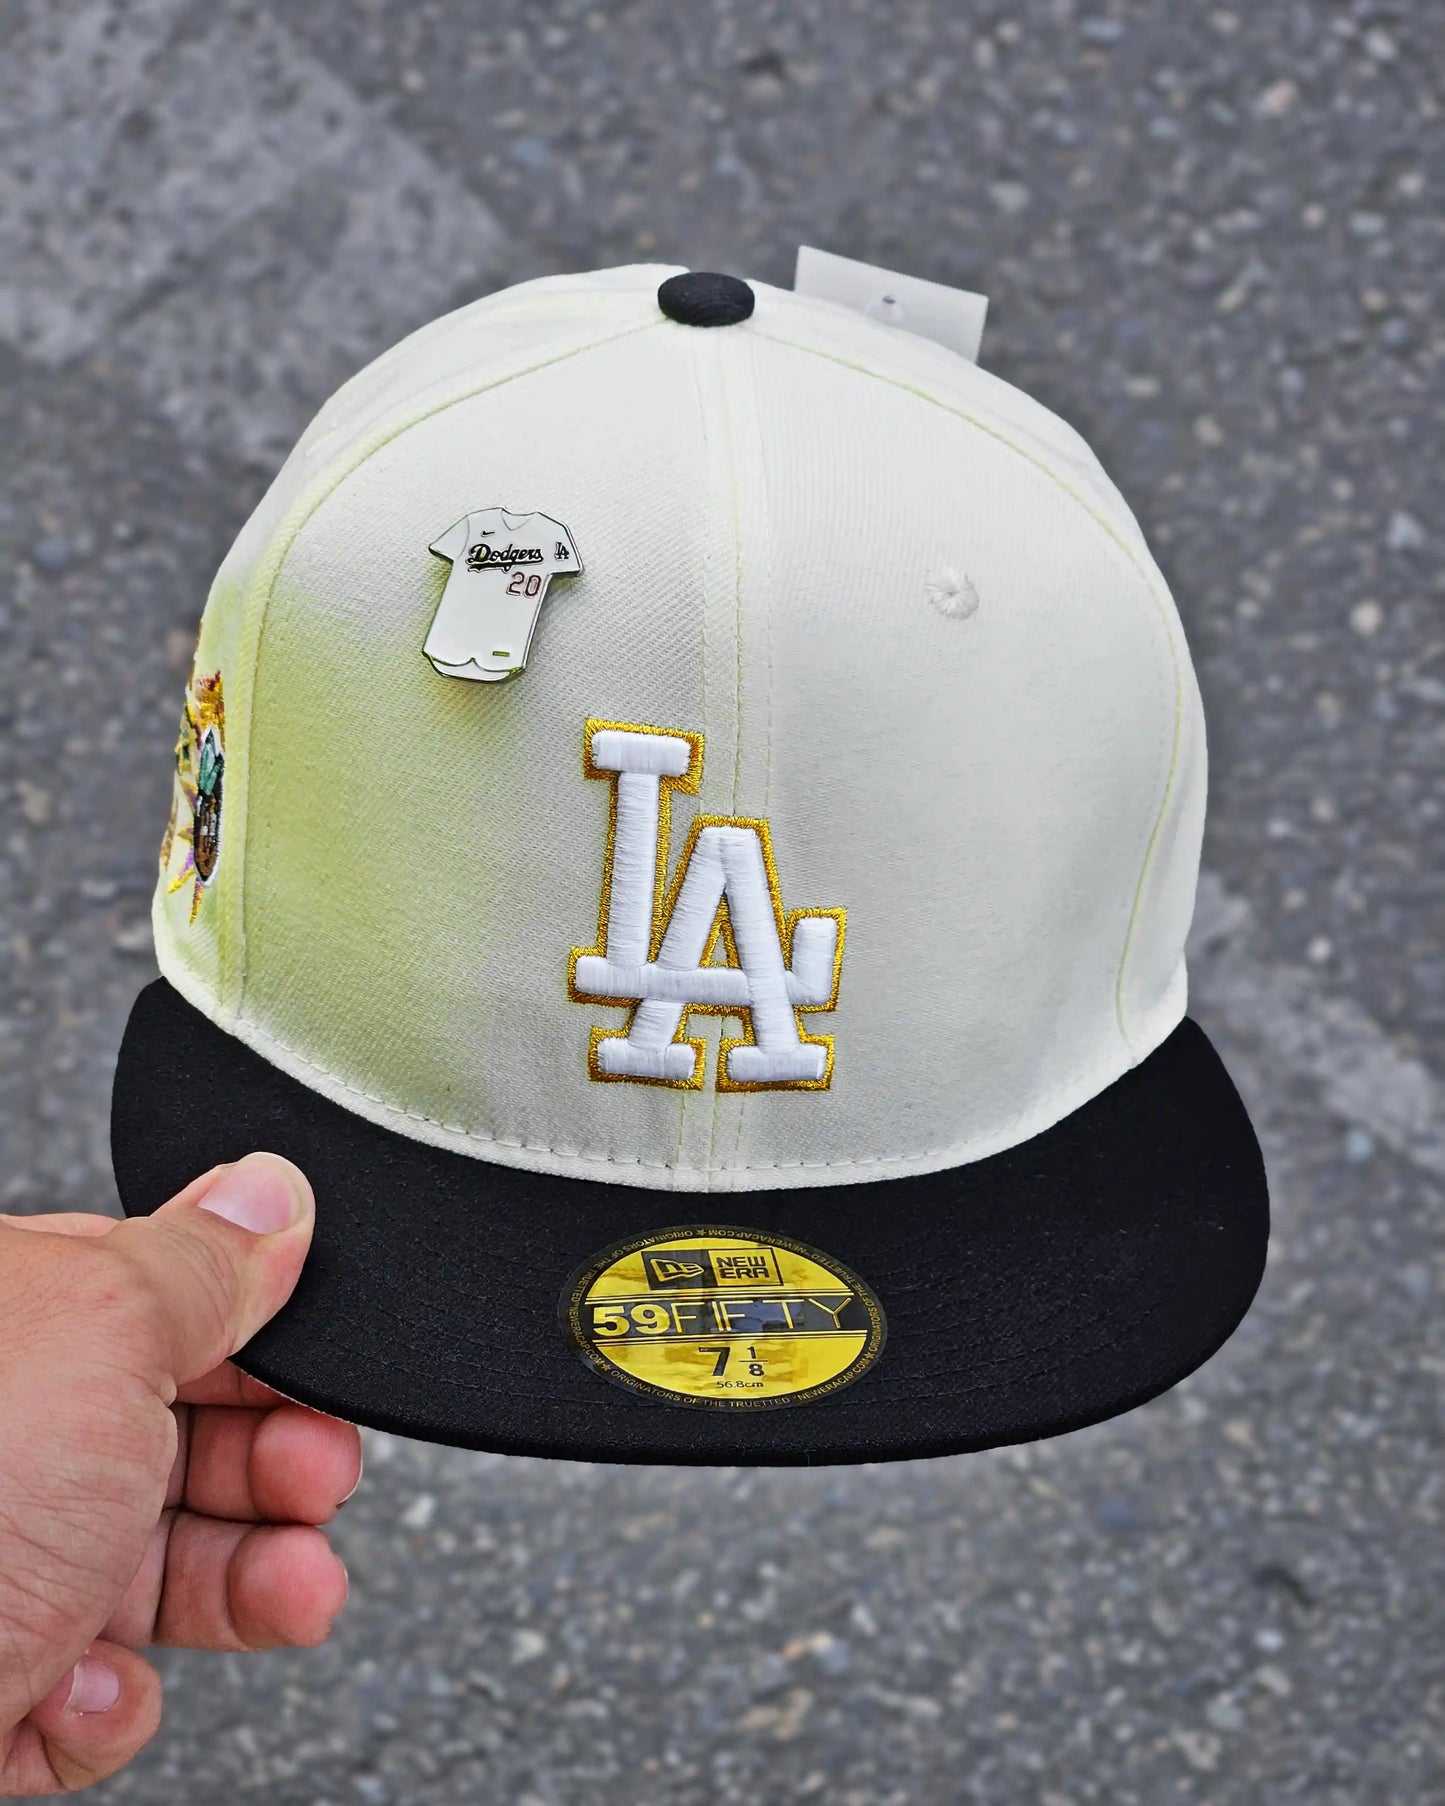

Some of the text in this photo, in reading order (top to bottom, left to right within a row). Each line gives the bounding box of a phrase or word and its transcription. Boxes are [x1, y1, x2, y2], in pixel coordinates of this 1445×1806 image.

[466, 543, 544, 573] Dodgers
[555, 542, 569, 561] LA
[507, 572, 542, 598] 20
[567, 718, 847, 1092] LA
[622, 1230, 693, 1251] ORIGINATORS
[708, 1229, 806, 1253] NEWERACAP.COM
[593, 1256, 610, 1271] THE
[609, 1249, 624, 1259] OF
[716, 1256, 766, 1267] NEW
[720, 1267, 770, 1279] ERA
[593, 1298, 852, 1336] 59FIFTY
[698, 1346, 731, 1376] 7
[611, 1369, 680, 1402] ORIGINATORS
[683, 1396, 700, 1405] OF
[798, 1358, 870, 1400] NEWERACAP.COM
[716, 1380, 764, 1388] 56.8cm
